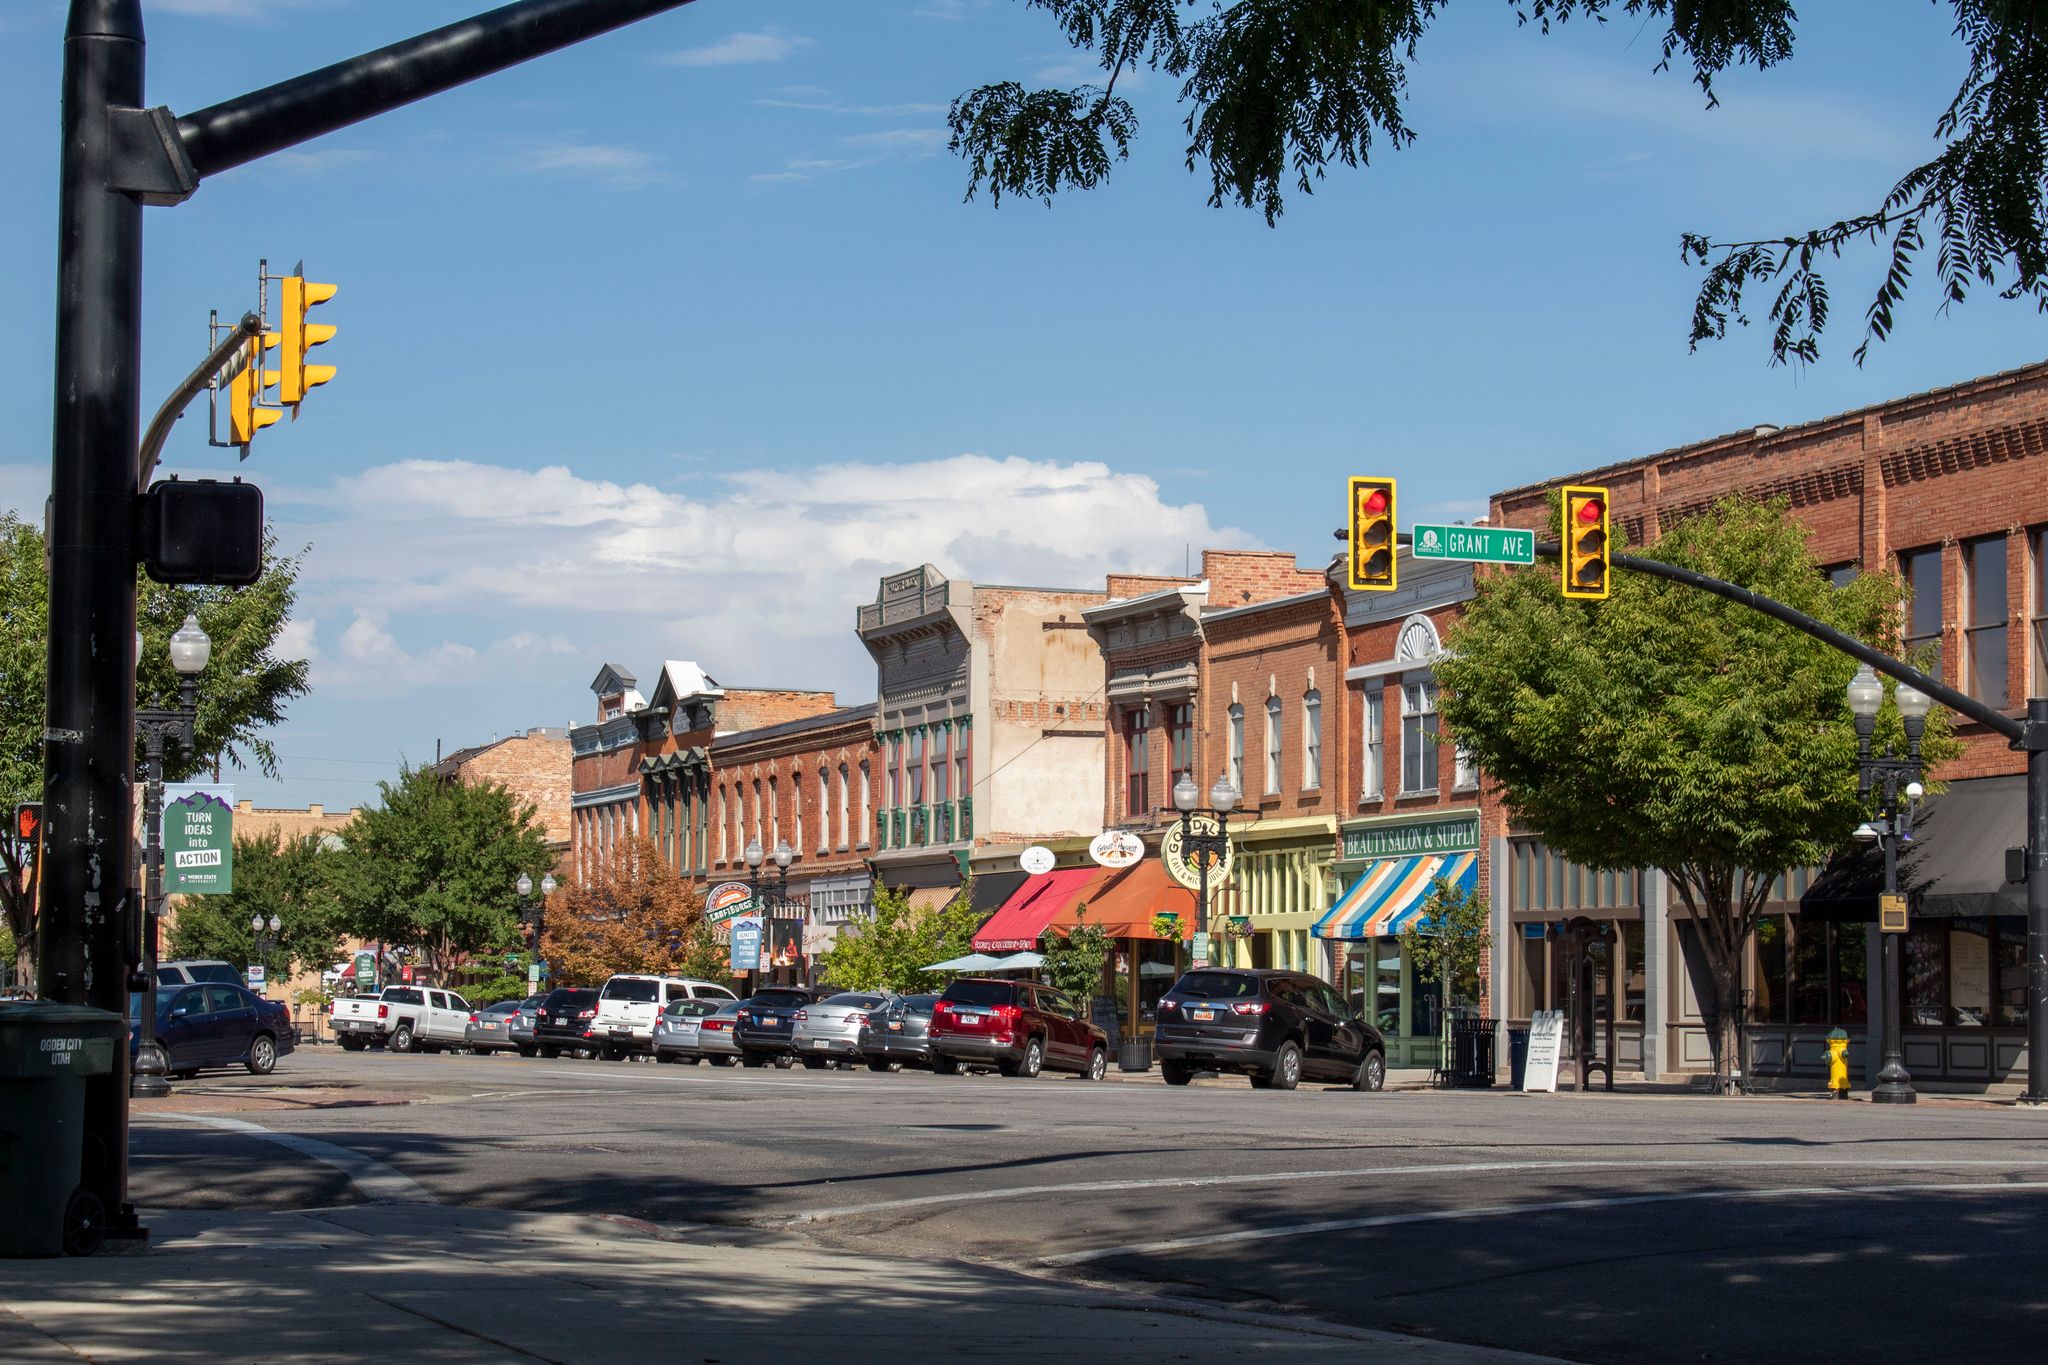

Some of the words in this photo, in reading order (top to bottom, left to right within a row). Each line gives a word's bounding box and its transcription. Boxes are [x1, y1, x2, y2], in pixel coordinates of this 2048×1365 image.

[1449, 533, 1490, 554] GRANT
[1502, 536, 1530, 557] AVE.
[186, 812, 212, 822] TURN
[184, 824, 213, 835] IDEAS
[189, 837, 208, 847] into
[1169, 820, 1202, 854] GOD
[1347, 831, 1388, 855] BEAUTY
[1389, 828, 1422, 852] SALON
[1424, 827, 1433, 849] &
[1436, 822, 1477, 848] SUPPLY
[179, 852, 218, 865] ACTION
[709, 899, 755, 922] CRAFTBURGE
[40, 1038, 67, 1051] OGDEN
[66, 1038, 83, 1050] CITY
[51, 1052, 71, 1065] UTAH
